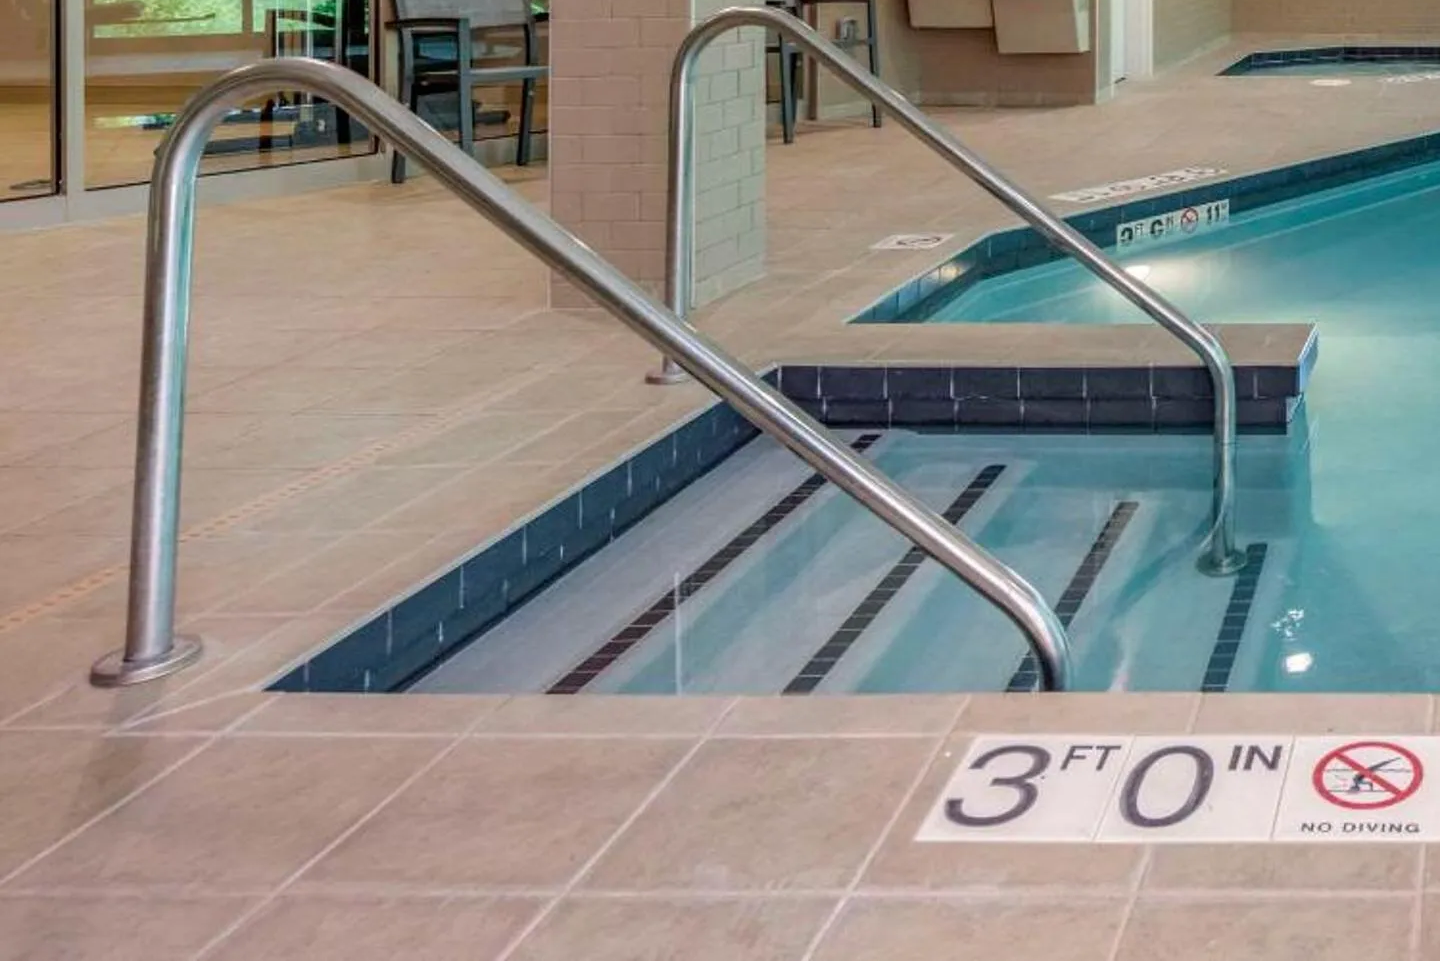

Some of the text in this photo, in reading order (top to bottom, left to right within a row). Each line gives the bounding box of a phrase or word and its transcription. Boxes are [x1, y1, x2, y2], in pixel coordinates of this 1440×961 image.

[944, 745, 1283, 828] 3 FT 0 IN
[1301, 822, 1420, 833] NO DIVING
